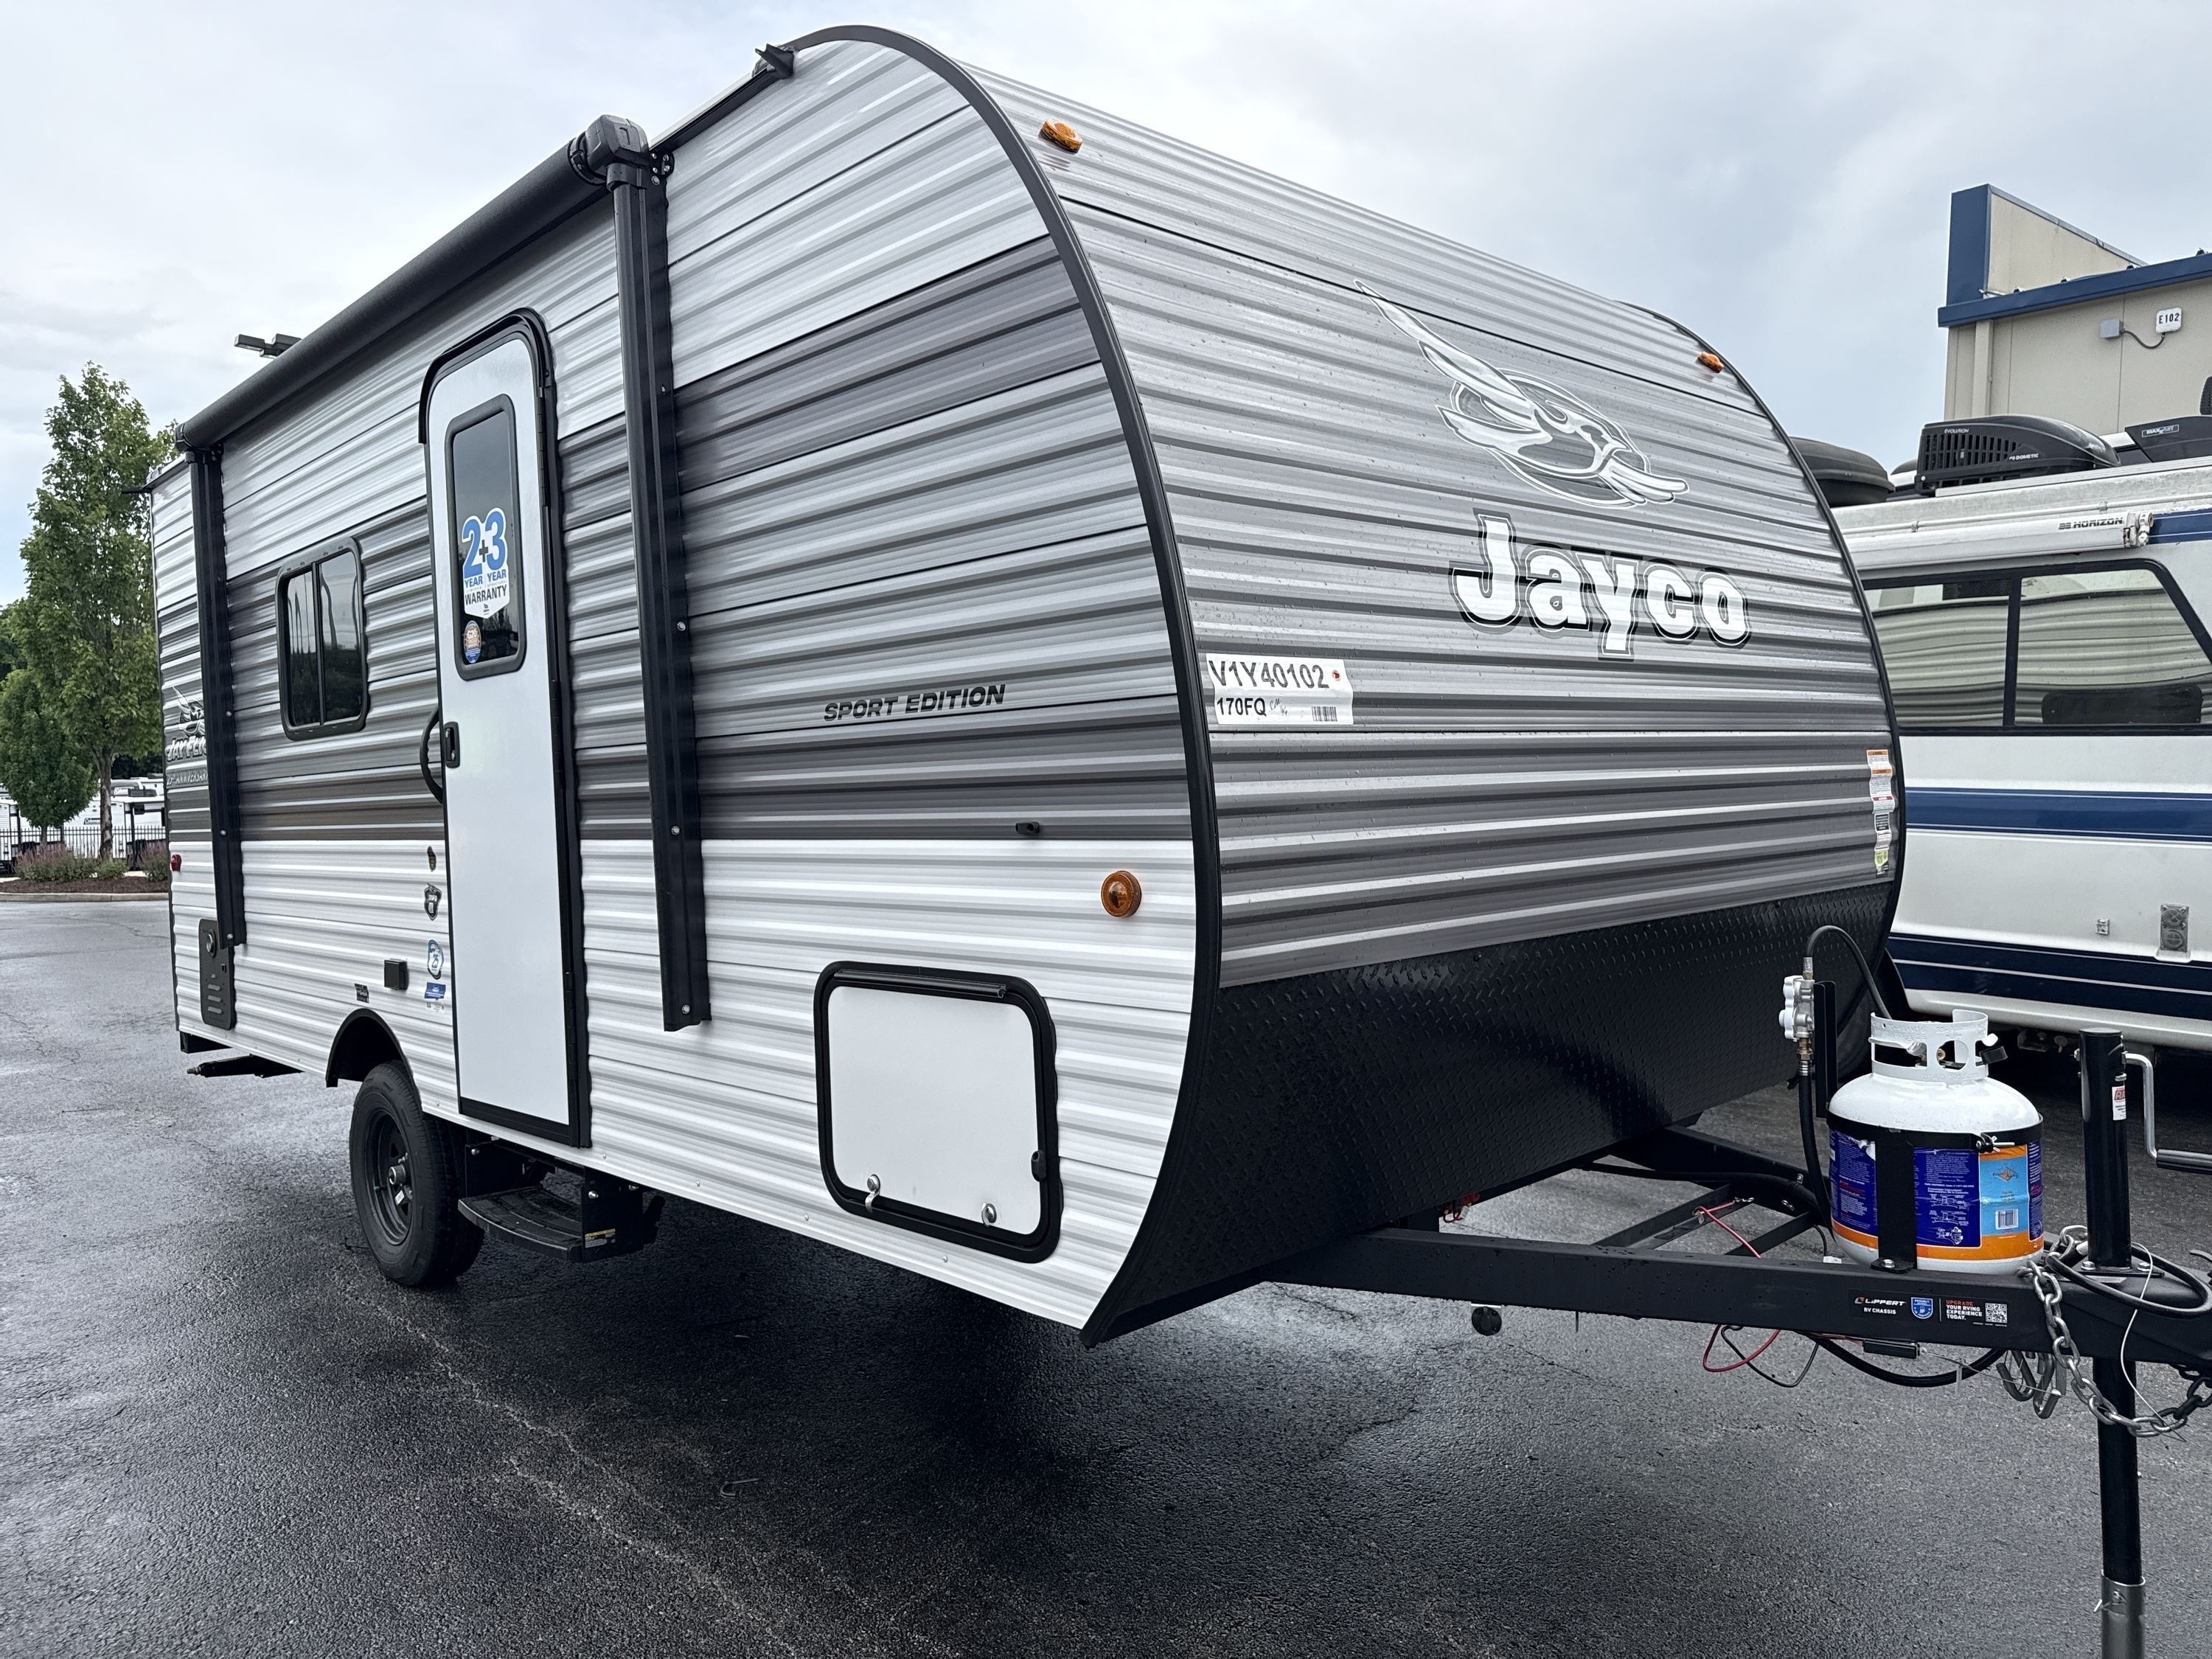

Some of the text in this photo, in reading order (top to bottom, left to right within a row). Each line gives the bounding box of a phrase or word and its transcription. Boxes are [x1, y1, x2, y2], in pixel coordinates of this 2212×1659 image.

[2073, 518, 2124, 528] HORIZON
[465, 569, 507, 588] YEAR YEAR
[1448, 508, 1752, 661] Jayco
[465, 584, 507, 605] WARRANTY
[1208, 660, 1329, 689] V1Y40102
[824, 684, 1006, 721] SPORT EDITION
[1217, 698, 1267, 717] 170FQ
[164, 738, 187, 762] JAY
